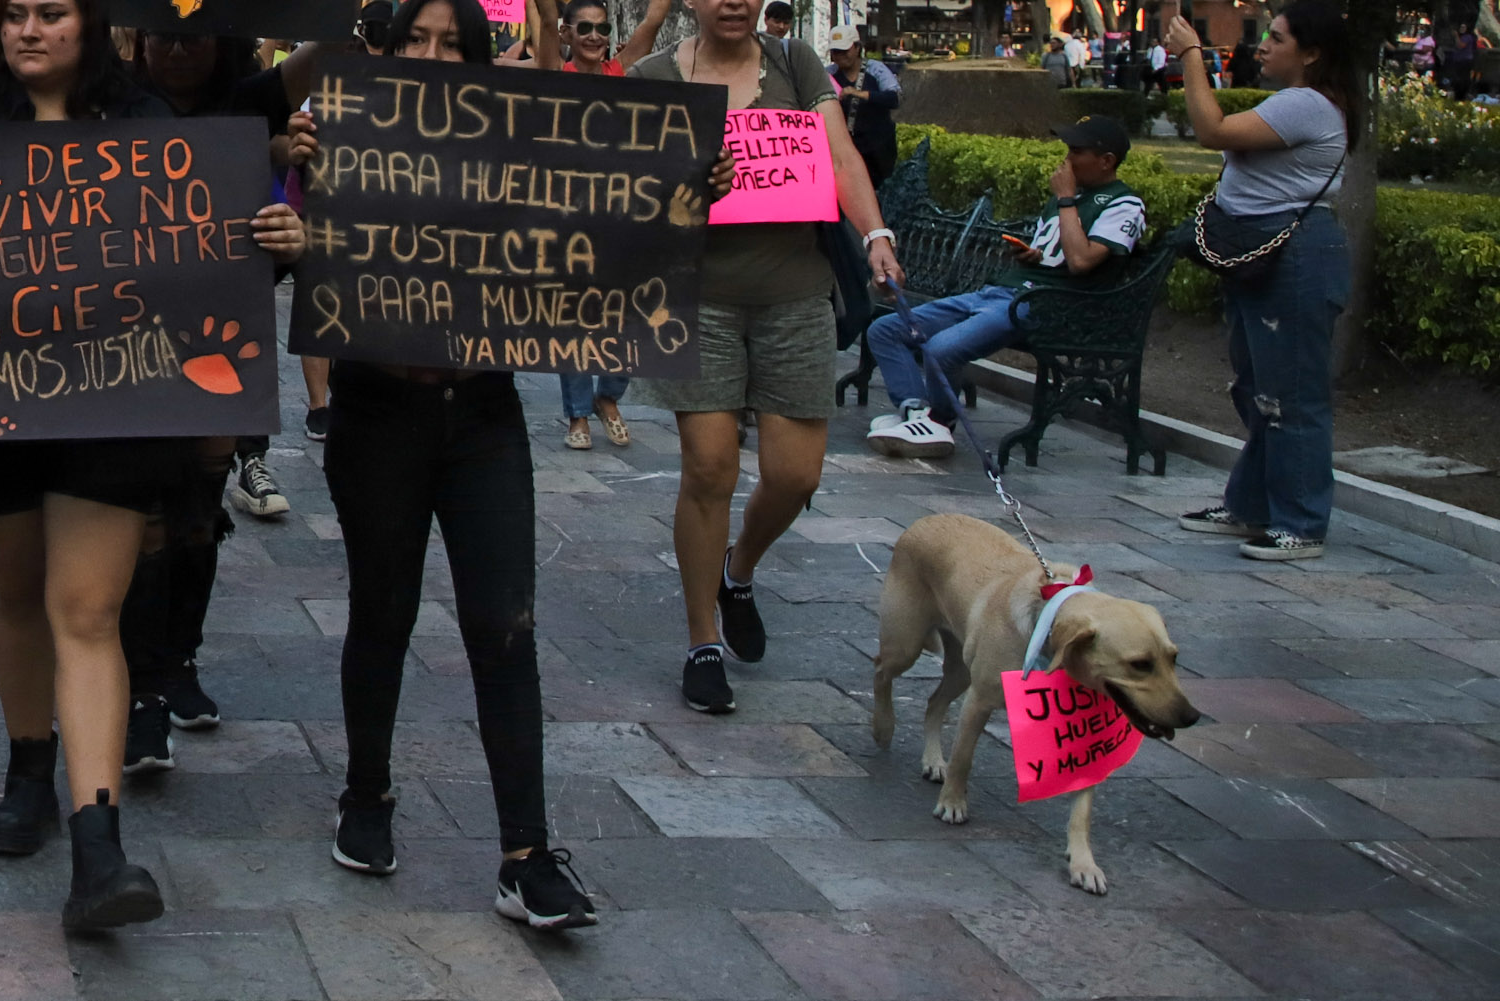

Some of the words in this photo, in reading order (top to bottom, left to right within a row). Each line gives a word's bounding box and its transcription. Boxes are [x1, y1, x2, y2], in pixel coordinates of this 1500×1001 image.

[310, 74, 698, 159] #JUSTICIA
[776, 113, 816, 130] PARA
[27, 137, 193, 186] DESEO
[723, 137, 814, 162] ELLITAS
[334, 145, 441, 197] PARA
[461, 160, 662, 222] HUELLITAS
[807, 164, 816, 184] Y
[139, 178, 212, 224] NO
[101, 217, 252, 268] ENTRE
[306, 217, 597, 276] #JUSTICIA
[357, 273, 453, 324] PARA
[481, 282, 626, 334] MUÑECA
[504, 337, 540, 367] NO
[695, 654, 720, 664] DKNY
[1028, 759, 1043, 782] Y
